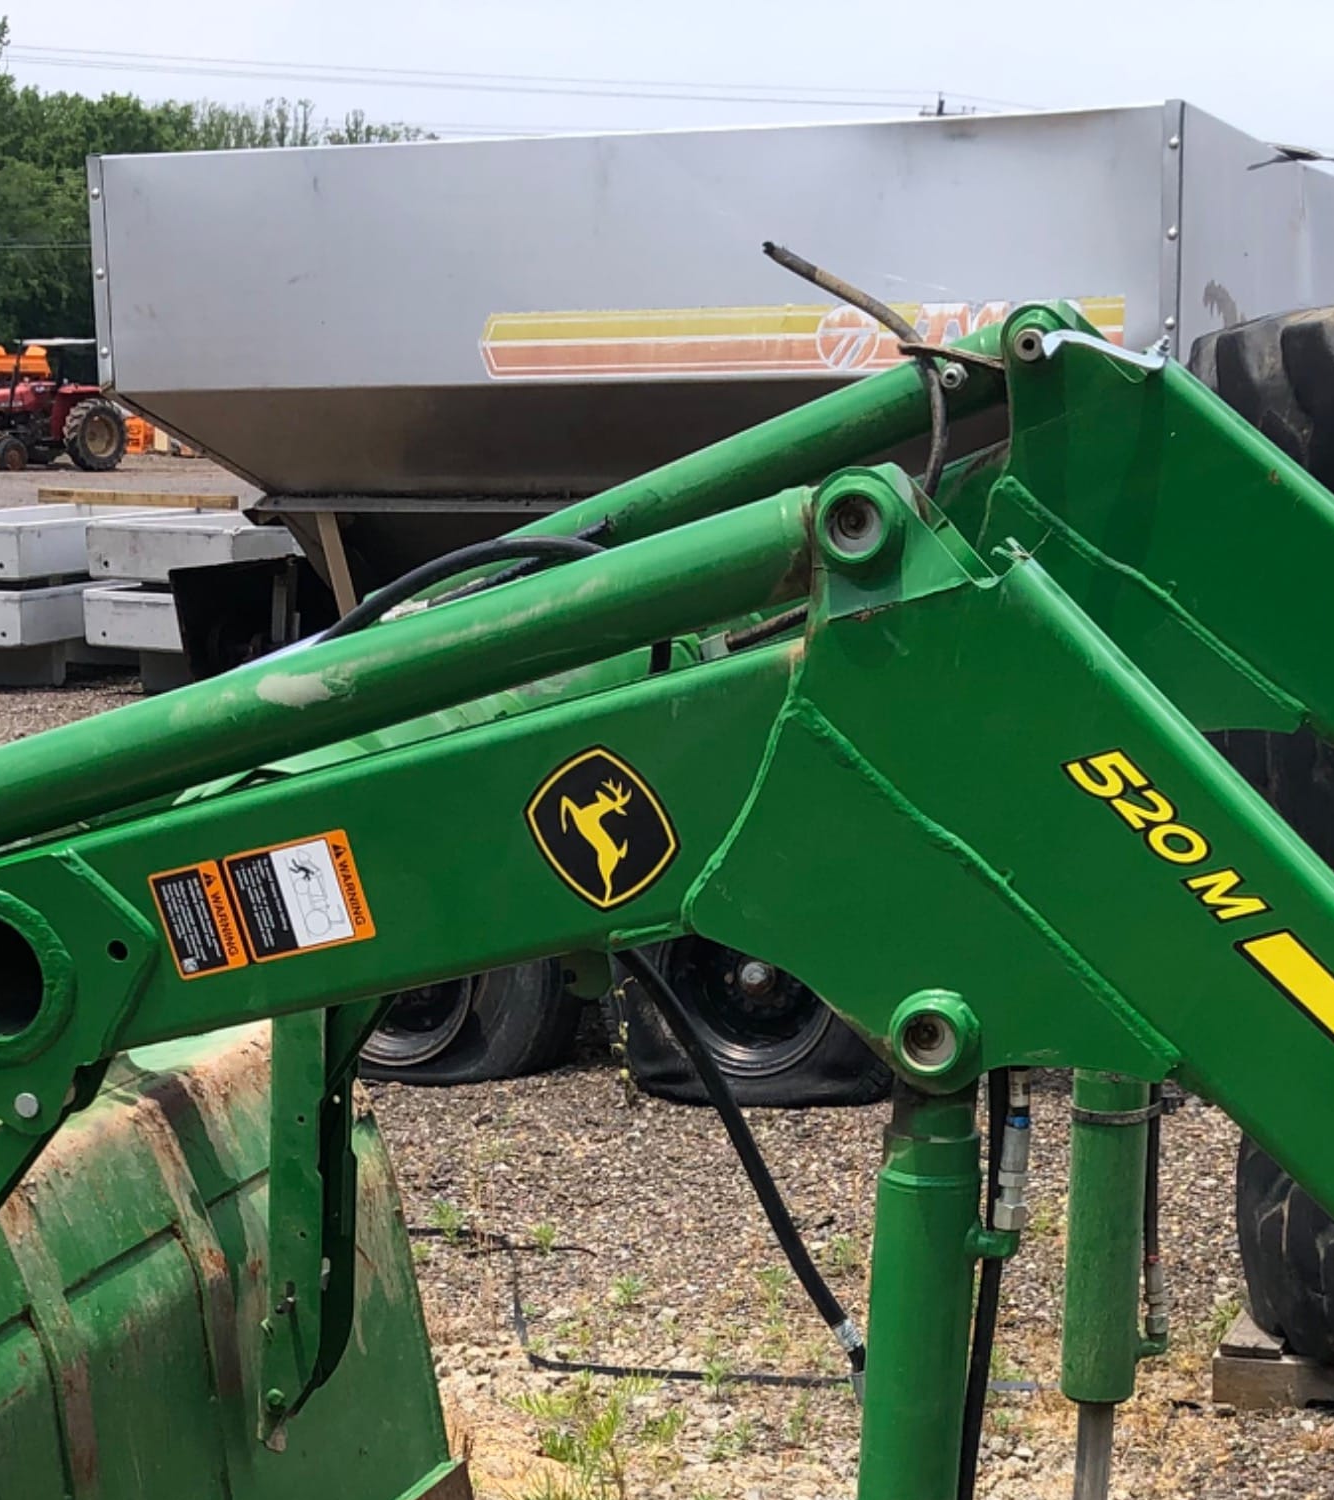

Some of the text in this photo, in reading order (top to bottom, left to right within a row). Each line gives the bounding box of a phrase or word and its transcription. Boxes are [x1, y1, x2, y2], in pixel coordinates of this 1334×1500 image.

[1063, 749, 1271, 922] 520M
[210, 891, 240, 958] WARNING
[337, 860, 367, 927] WARNING
